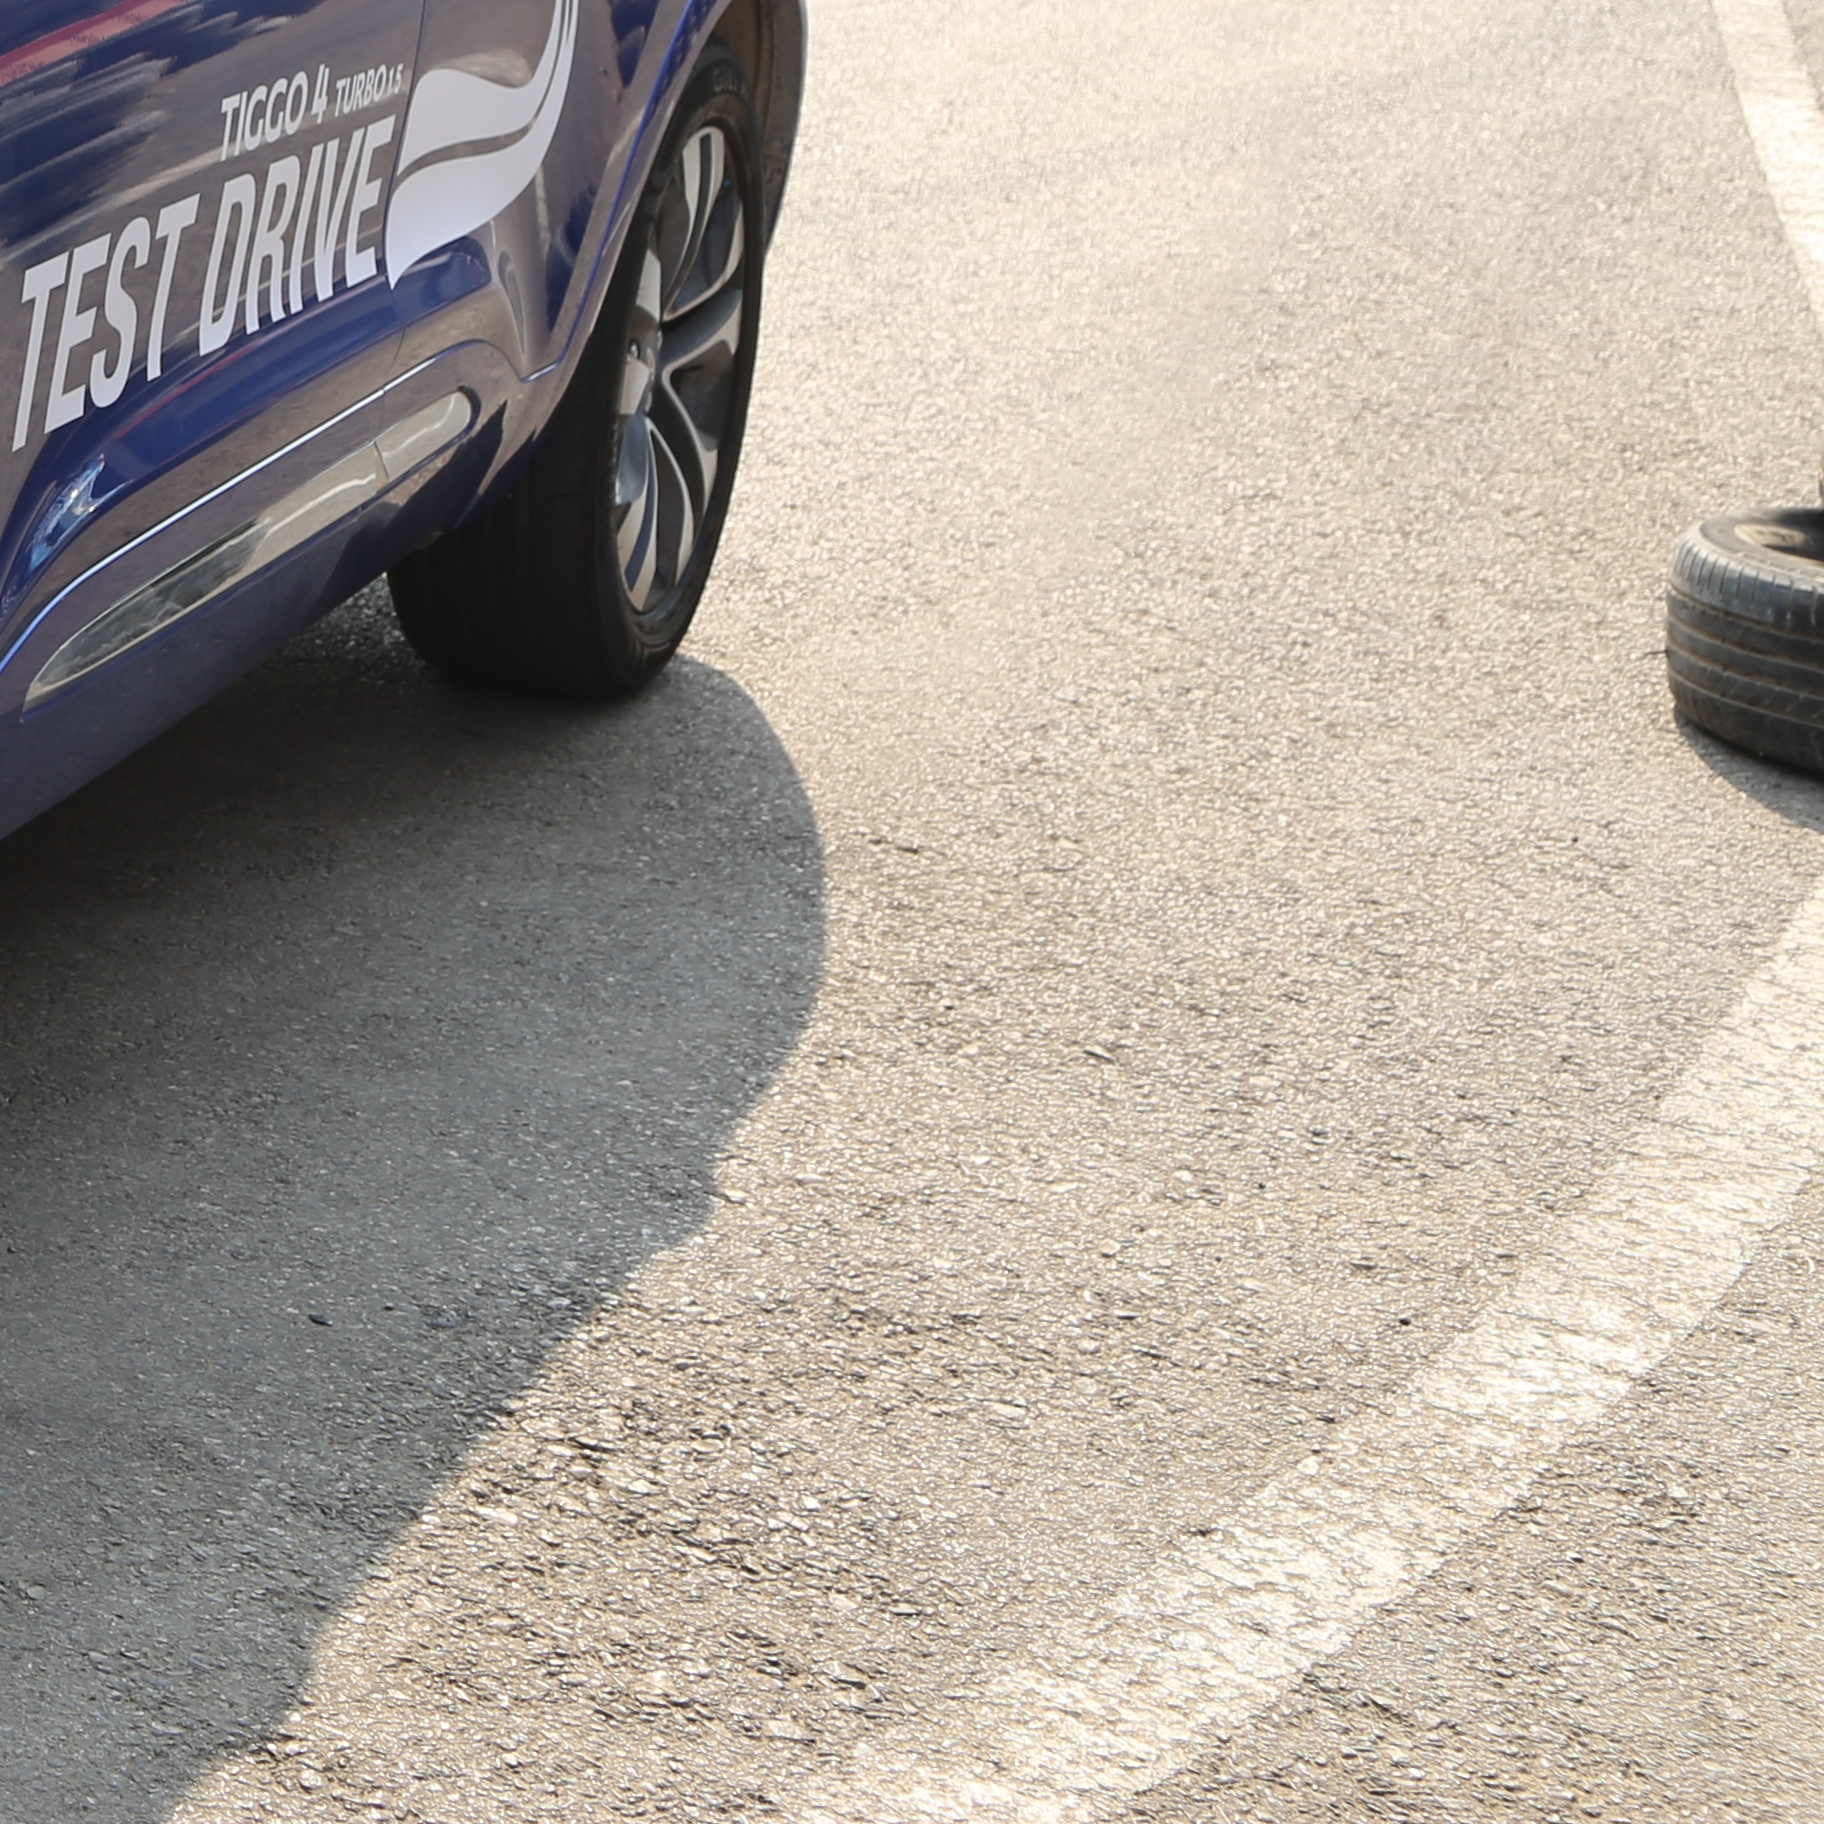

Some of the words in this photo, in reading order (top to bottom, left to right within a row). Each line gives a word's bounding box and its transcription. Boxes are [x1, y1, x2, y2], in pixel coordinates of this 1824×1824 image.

[220, 71, 310, 162] TIGGO
[311, 63, 331, 124] 4
[334, 64, 388, 117] TURBO
[12, 192, 201, 452] TEST
[198, 114, 397, 357] DRIVE
